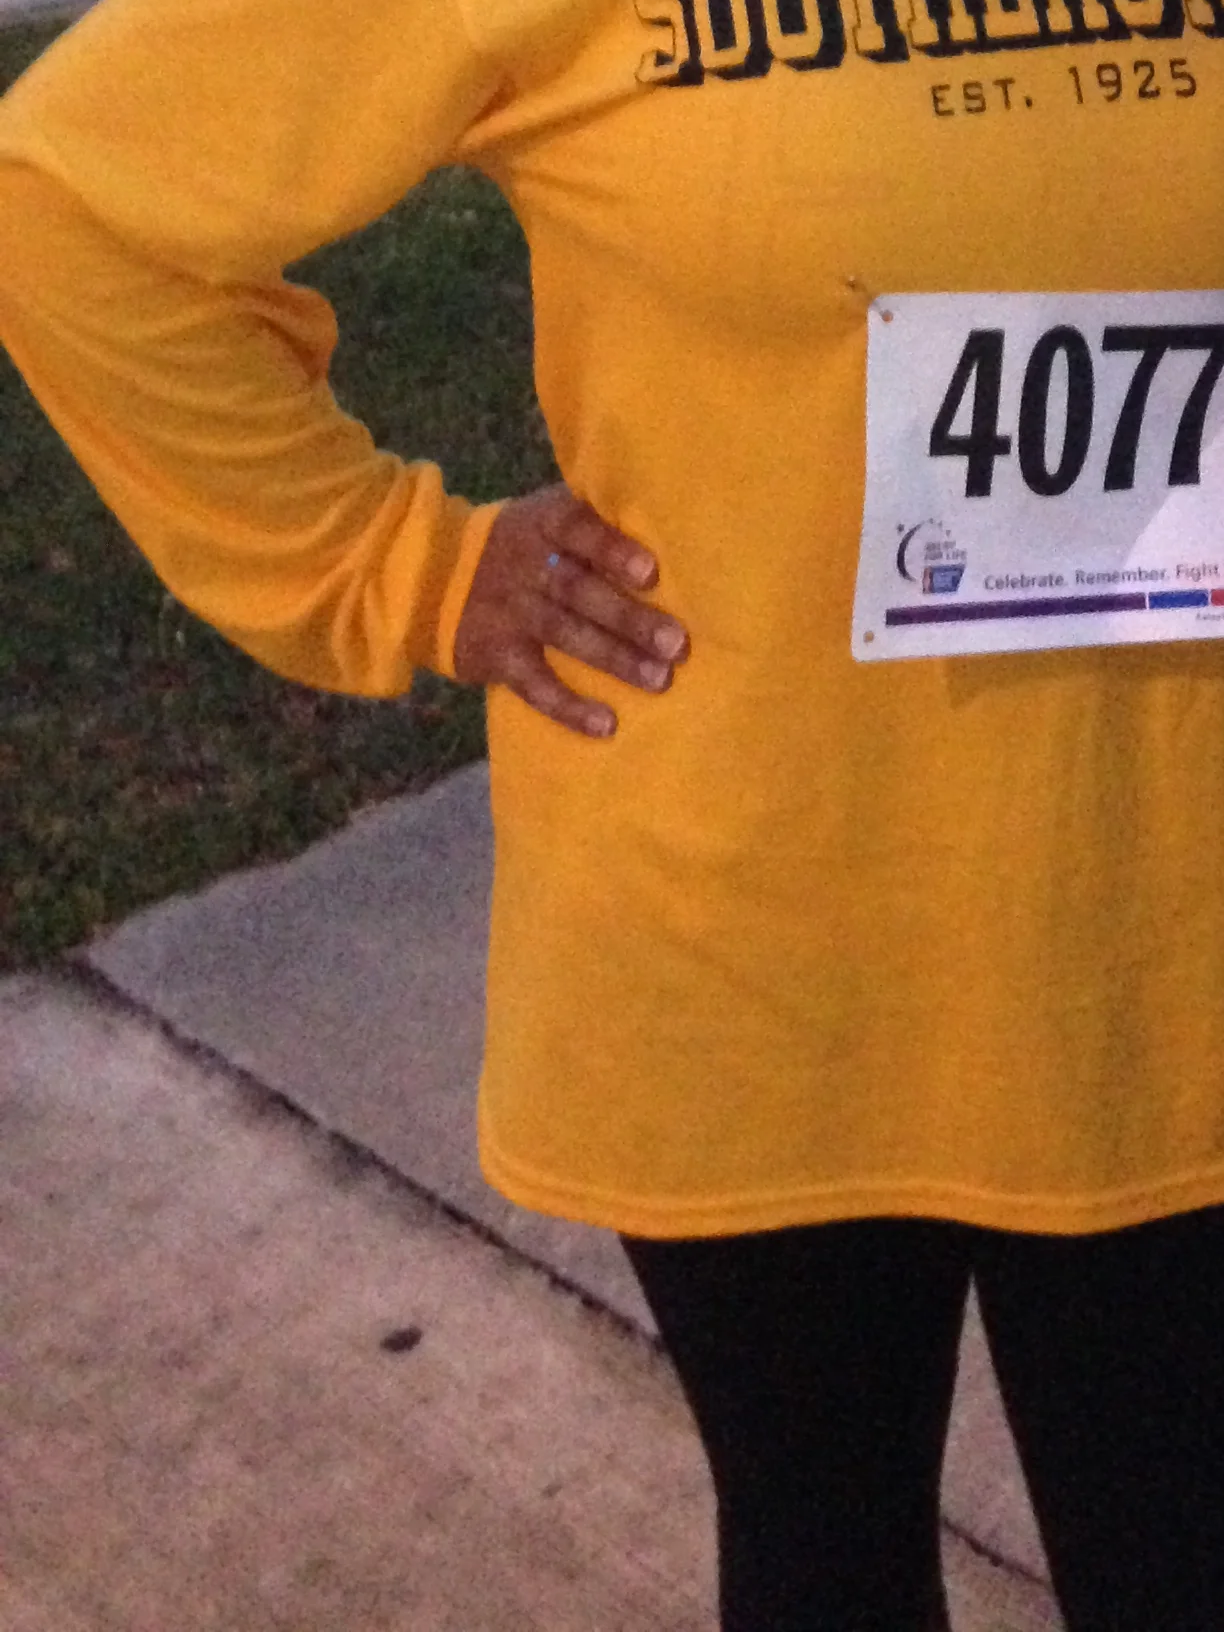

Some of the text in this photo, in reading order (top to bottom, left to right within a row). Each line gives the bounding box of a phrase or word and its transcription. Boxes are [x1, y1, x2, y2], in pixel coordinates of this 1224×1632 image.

[932, 58, 1197, 118] EST. 1925
[1175, 562, 1219, 582] Fight
